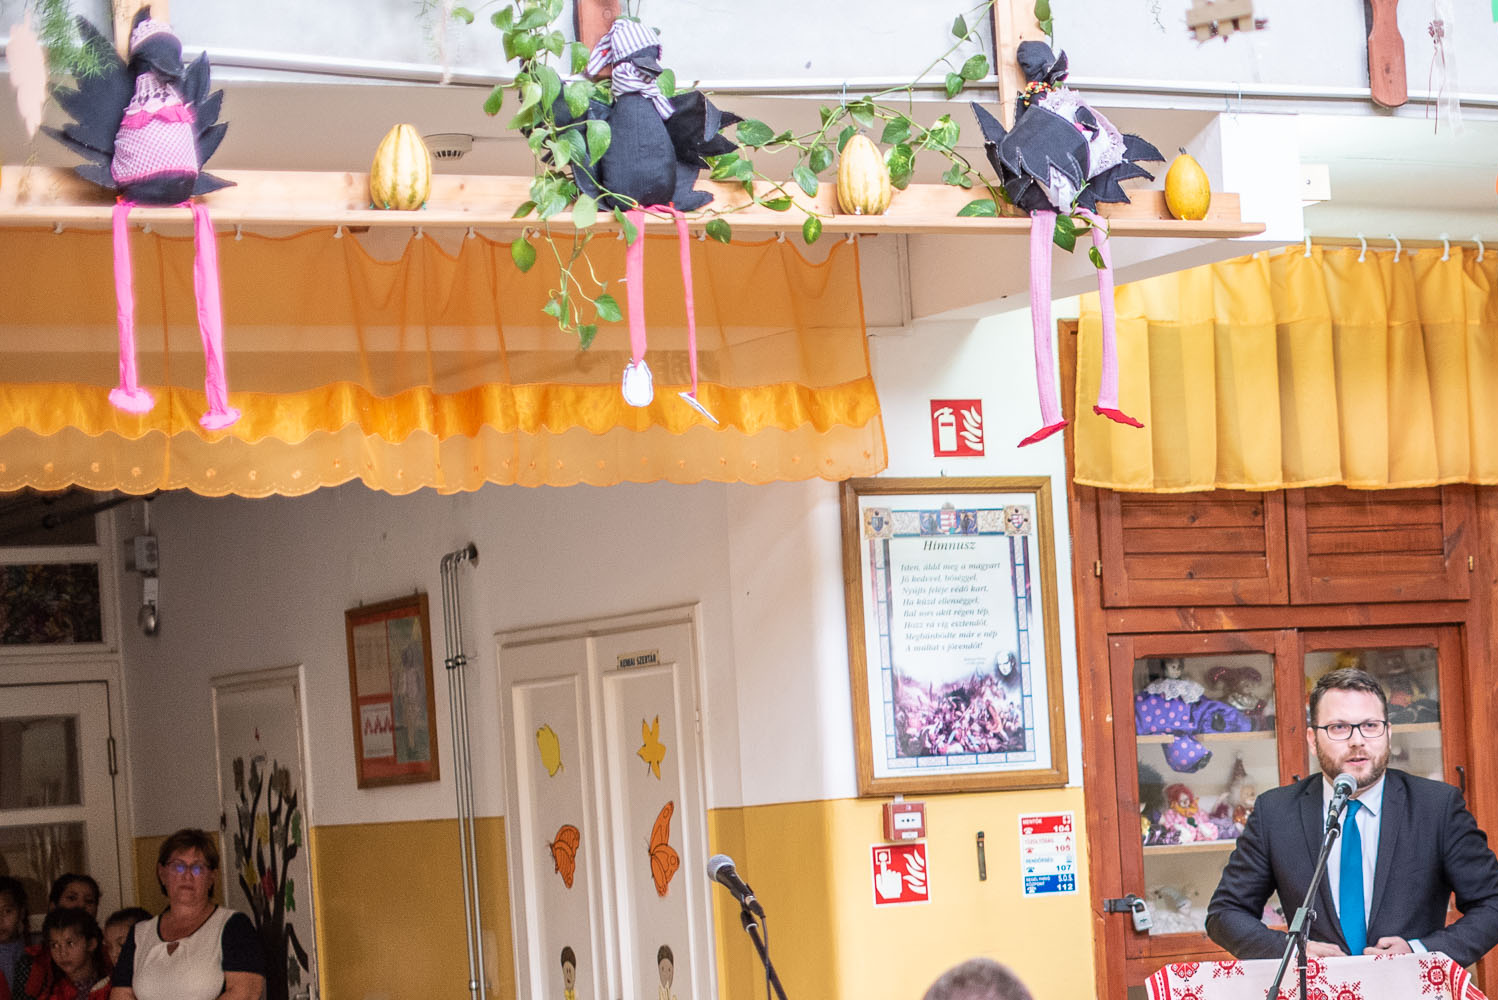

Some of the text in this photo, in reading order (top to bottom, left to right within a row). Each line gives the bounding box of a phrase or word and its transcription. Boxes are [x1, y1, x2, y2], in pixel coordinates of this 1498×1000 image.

[923, 540, 976, 551] Himnusz
[1053, 824, 1070, 833] 104
[1057, 883, 1073, 891] 112
